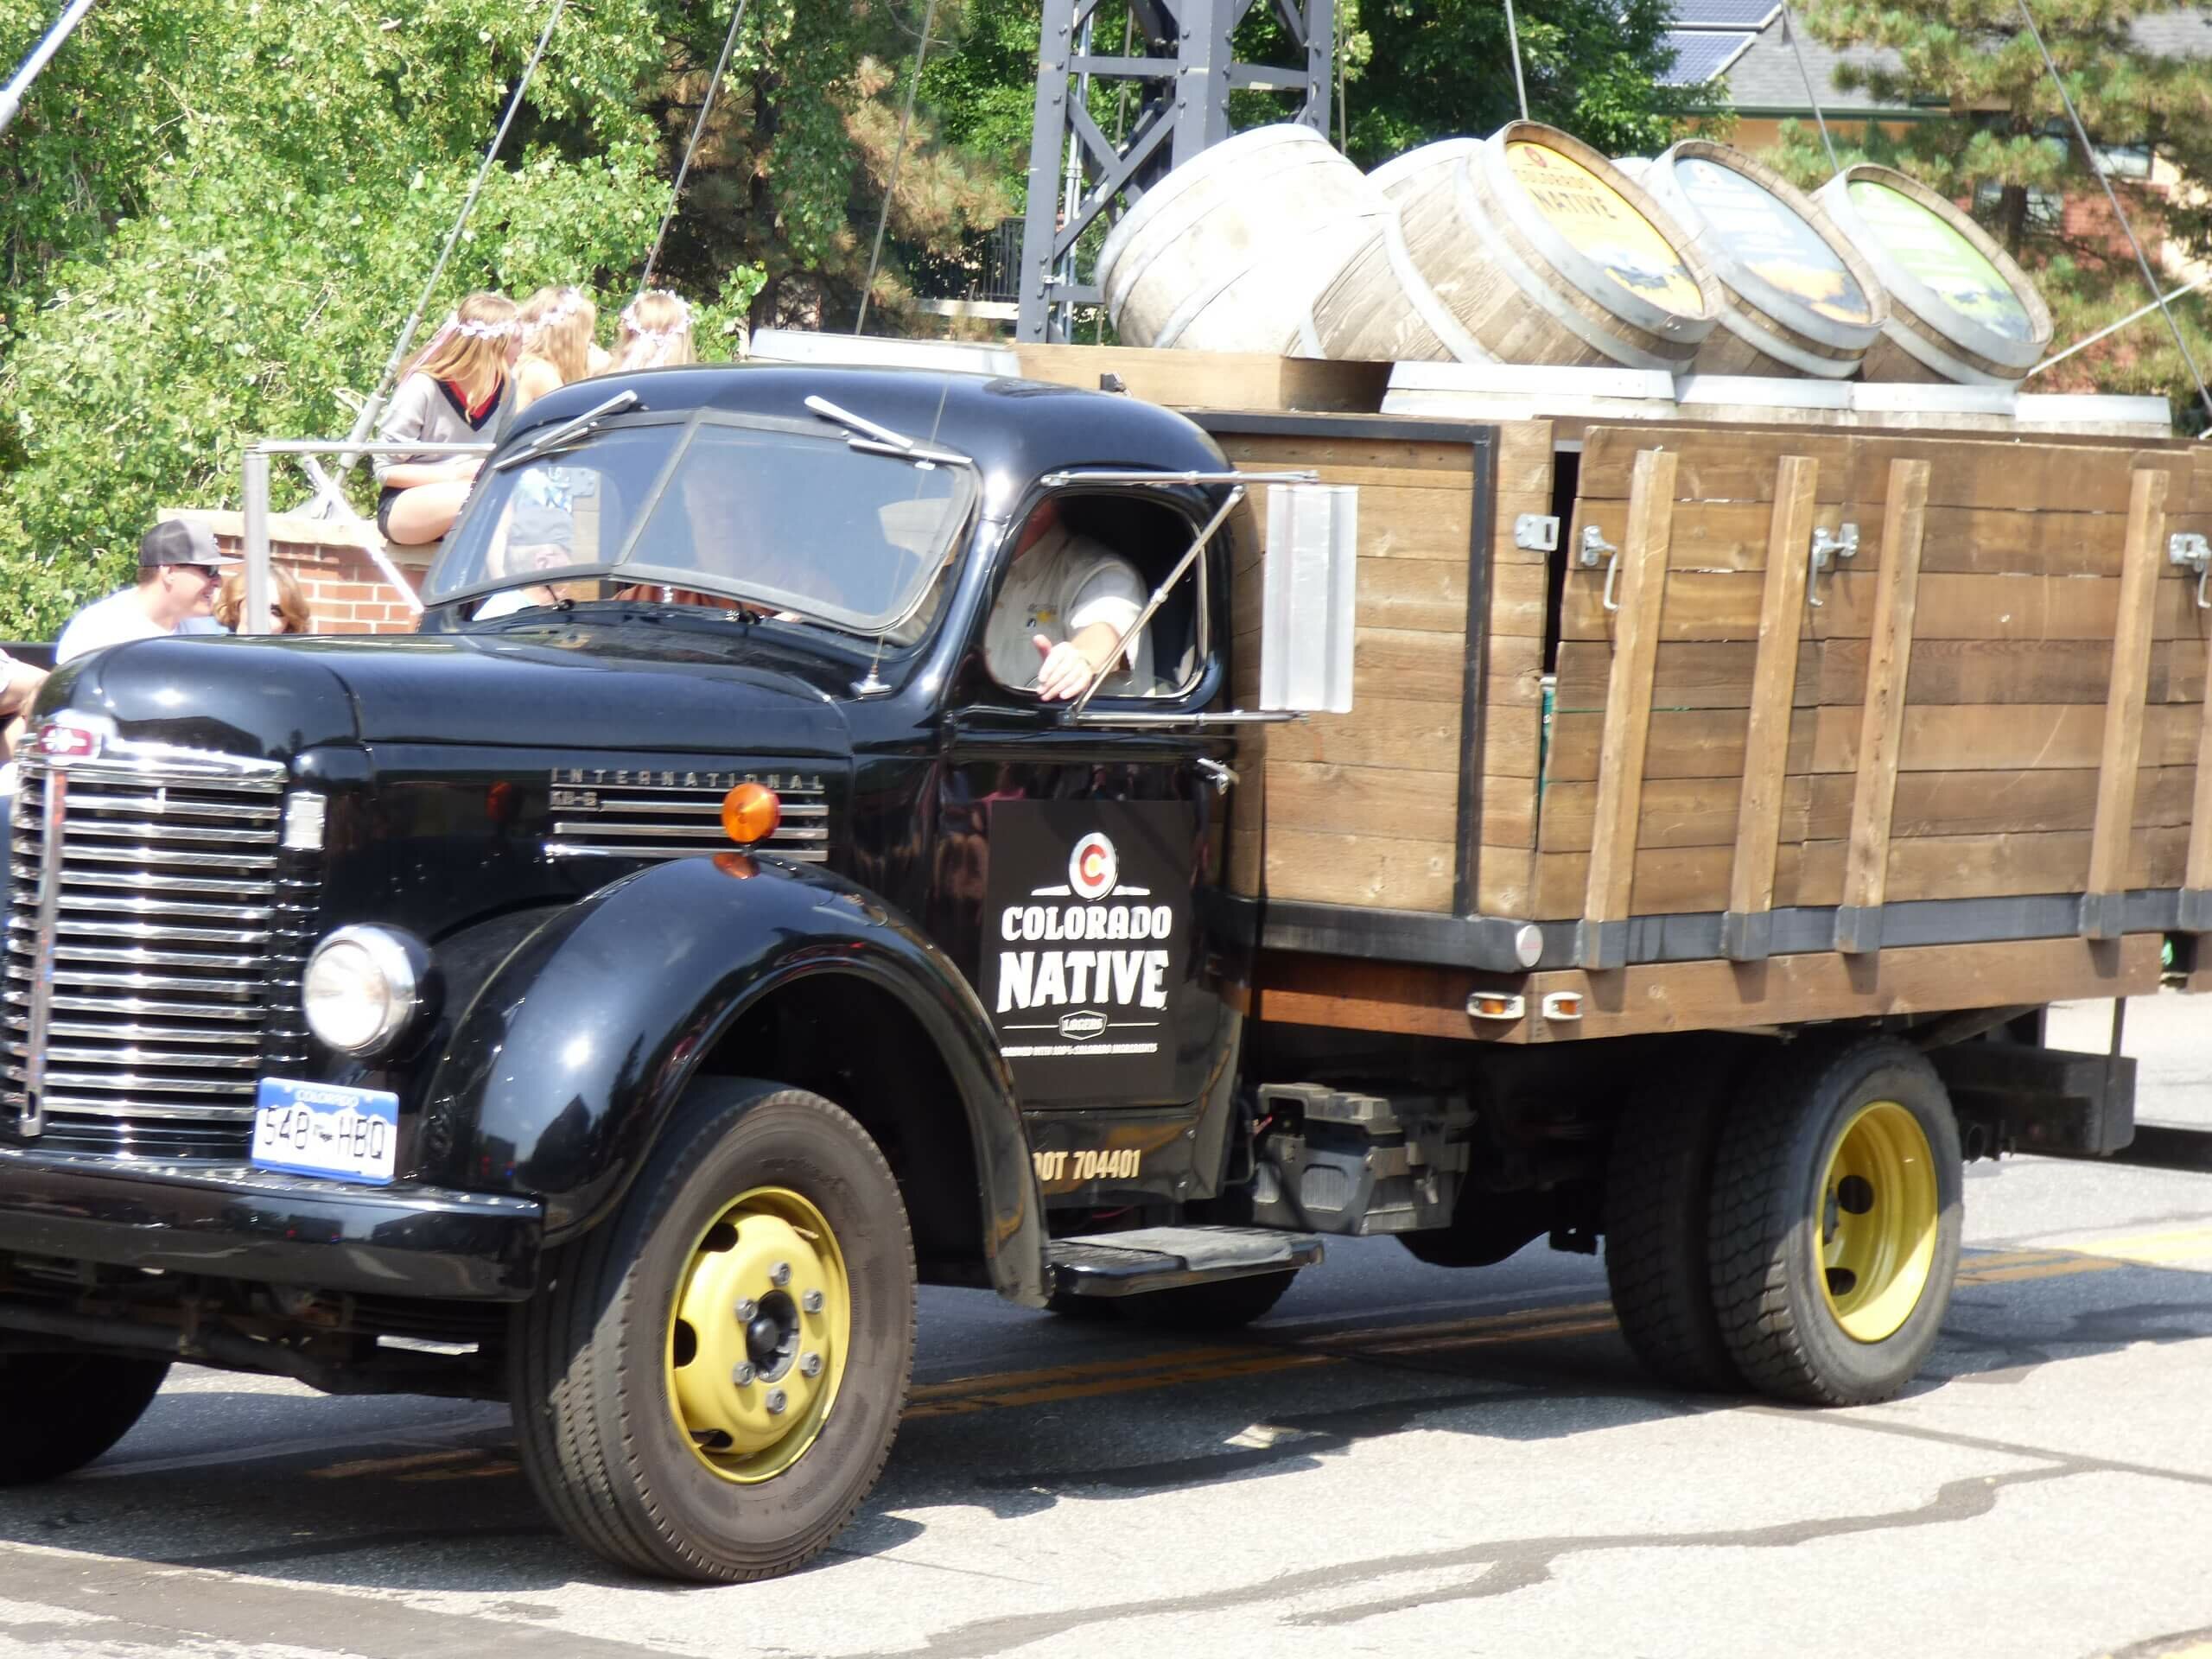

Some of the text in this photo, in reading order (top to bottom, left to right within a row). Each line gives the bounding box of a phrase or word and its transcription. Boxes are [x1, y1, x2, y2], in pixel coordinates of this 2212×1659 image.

[1529, 188, 1618, 221] NATIVE
[550, 766, 825, 790] INTERNATIONAL
[1078, 843, 1107, 887] C
[1001, 906, 1173, 942] COLORADO
[995, 950, 1169, 1014] NATIVE
[1071, 1149, 1141, 1179] 704401
